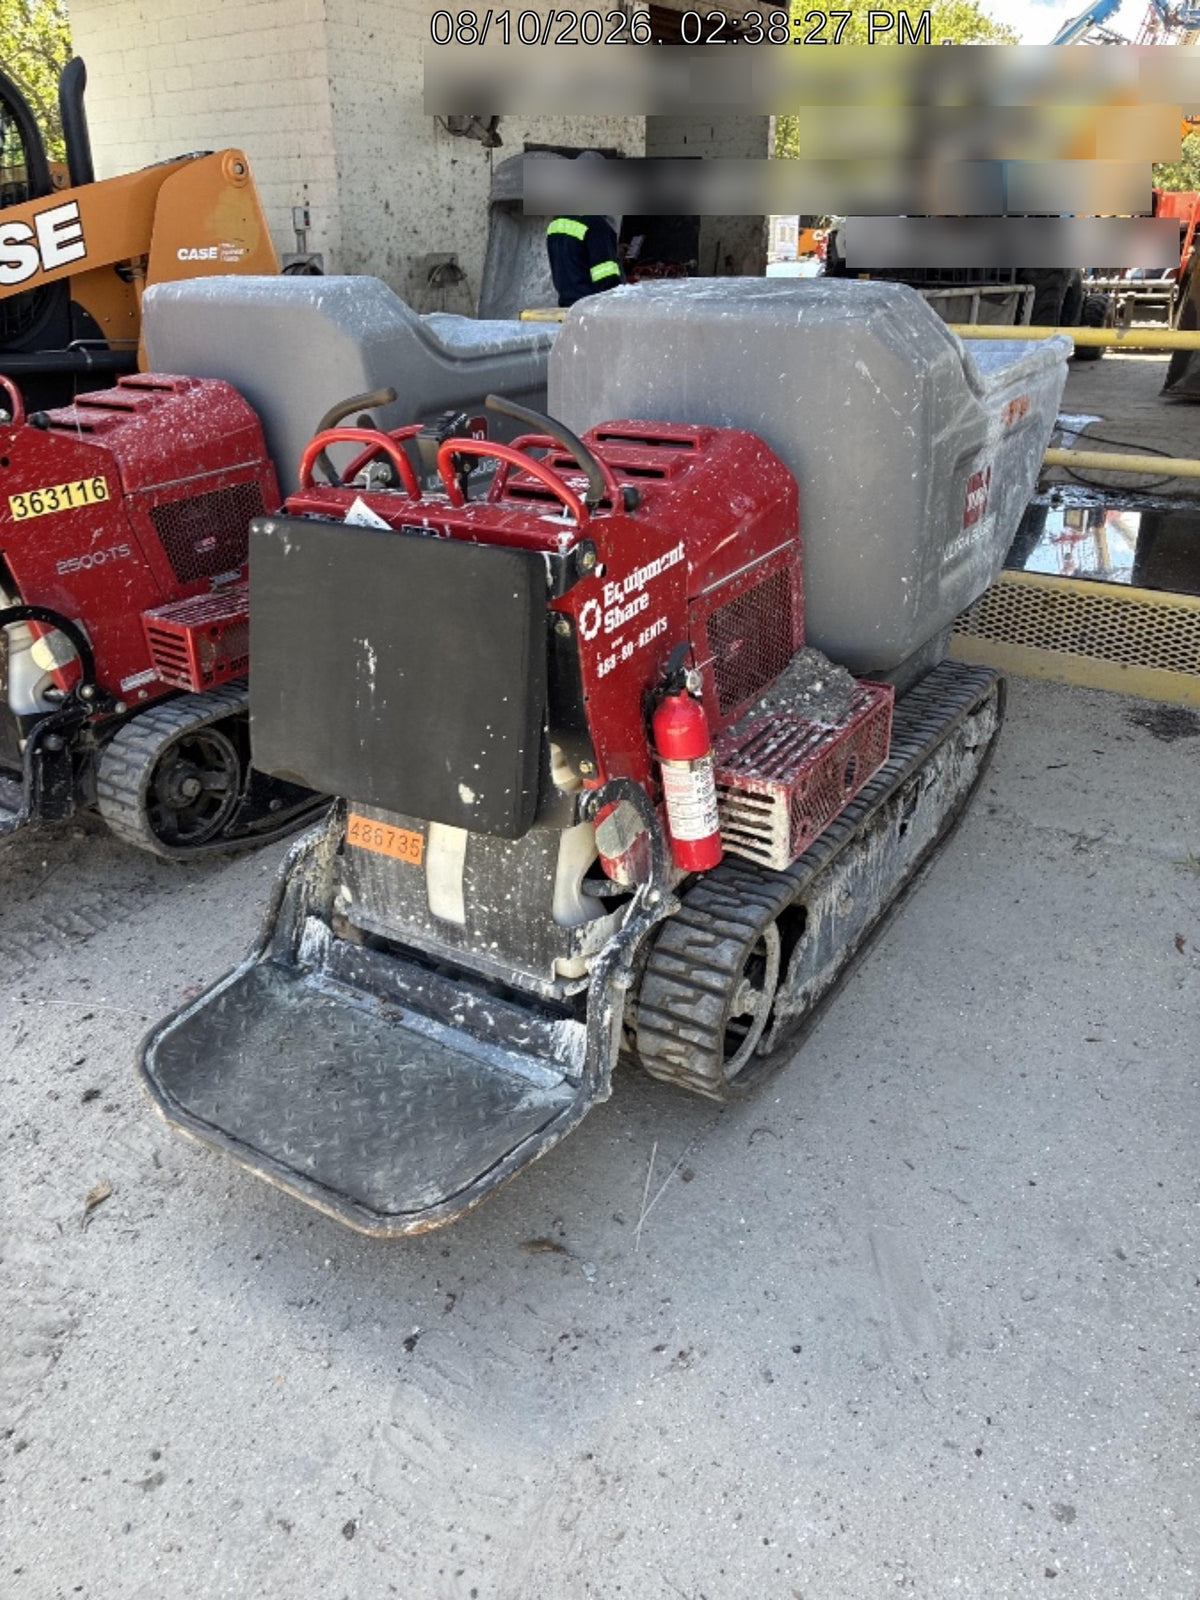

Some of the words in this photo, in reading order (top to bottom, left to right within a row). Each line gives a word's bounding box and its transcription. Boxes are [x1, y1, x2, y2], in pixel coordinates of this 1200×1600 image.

[0, 200, 87, 286] SE
[177, 246, 218, 261] CASE
[12, 478, 106, 518] 363116
[602, 540, 685, 608] Equipment
[604, 592, 650, 634] Share
[350, 822, 420, 858] 486735
